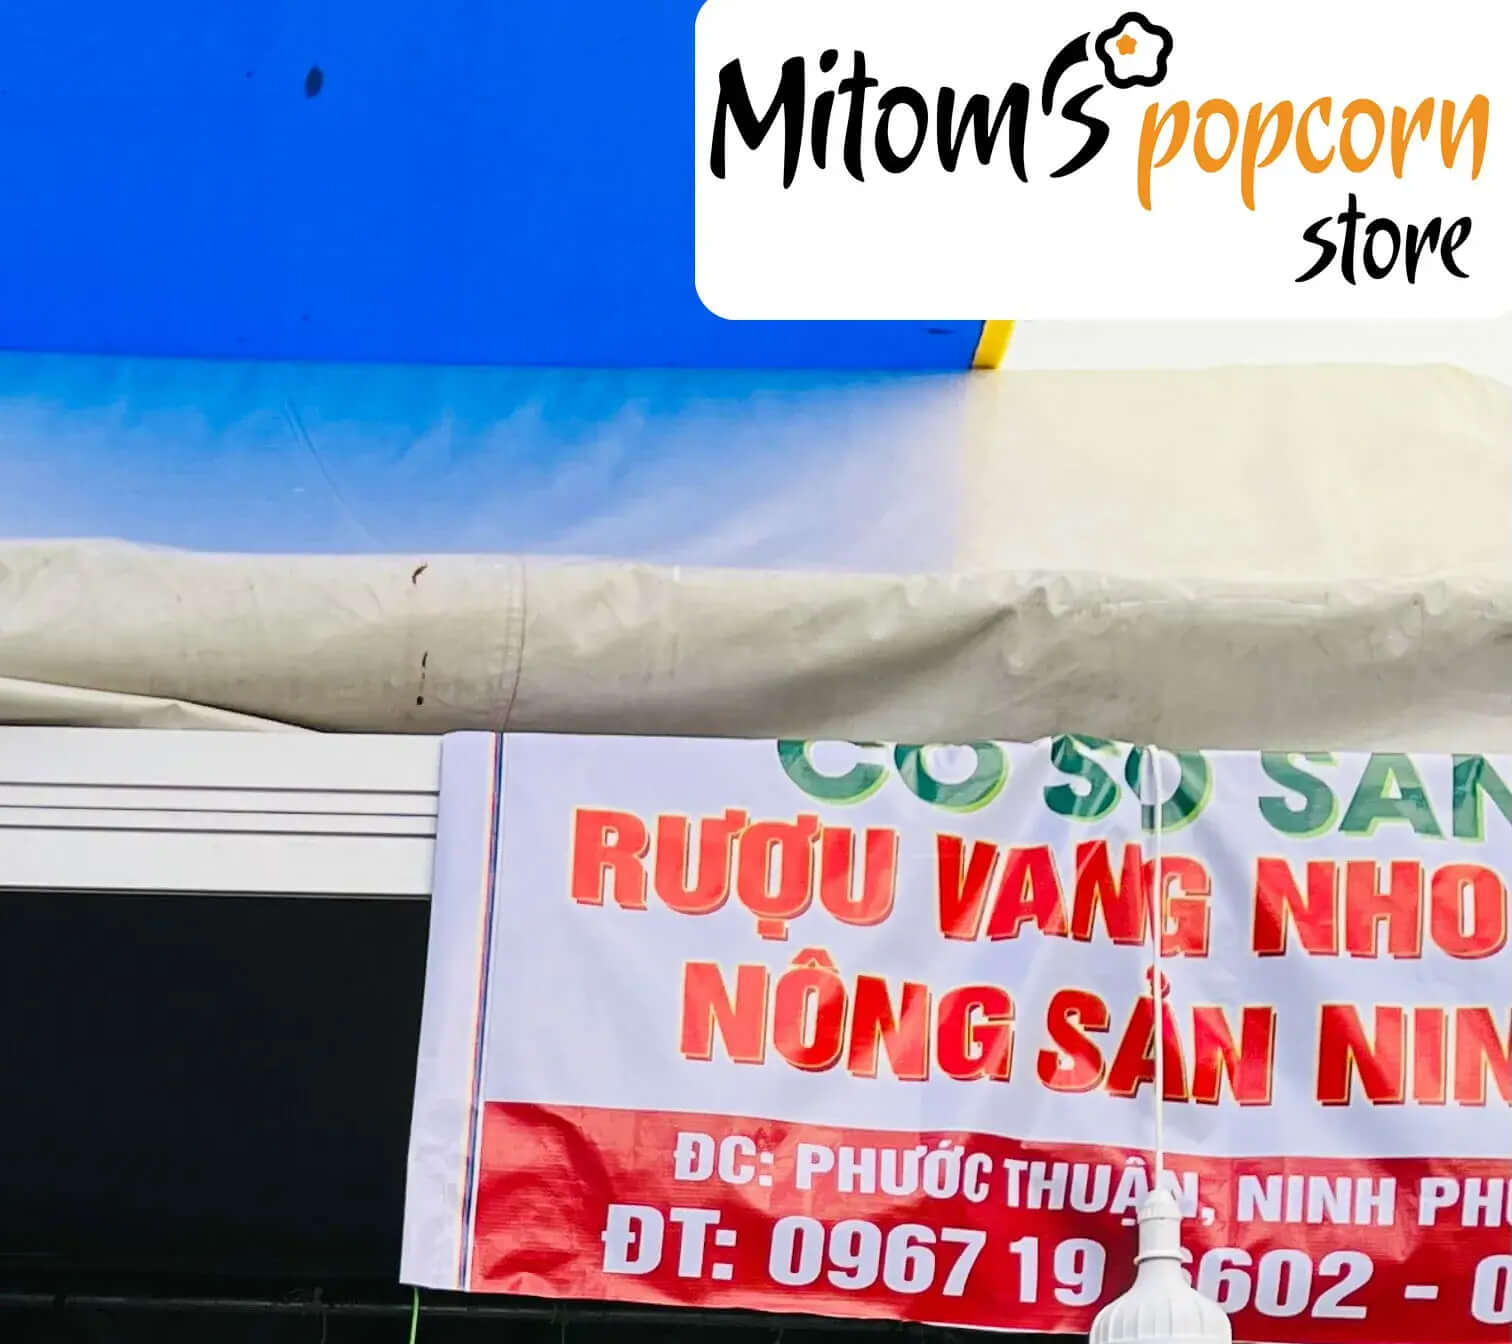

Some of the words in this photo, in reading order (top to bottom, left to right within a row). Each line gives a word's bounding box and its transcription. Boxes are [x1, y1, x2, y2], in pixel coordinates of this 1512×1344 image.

[571, 807, 900, 940] RƯỢU
[935, 832, 1211, 958] VANG
[1252, 855, 1509, 960] NHO
[680, 947, 1015, 1083] NÔNG
[1037, 964, 1278, 1106] SẢN
[673, 1131, 774, 1187] ĐC:
[795, 1139, 993, 1202] PHƯỚC
[1237, 1175, 1396, 1226] NINH
[601, 1203, 737, 1281] ĐT:
[768, 1215, 987, 1297] 0967
[1009, 1236, 1107, 1308] 19
[1181, 1246, 1375, 1320] 602
